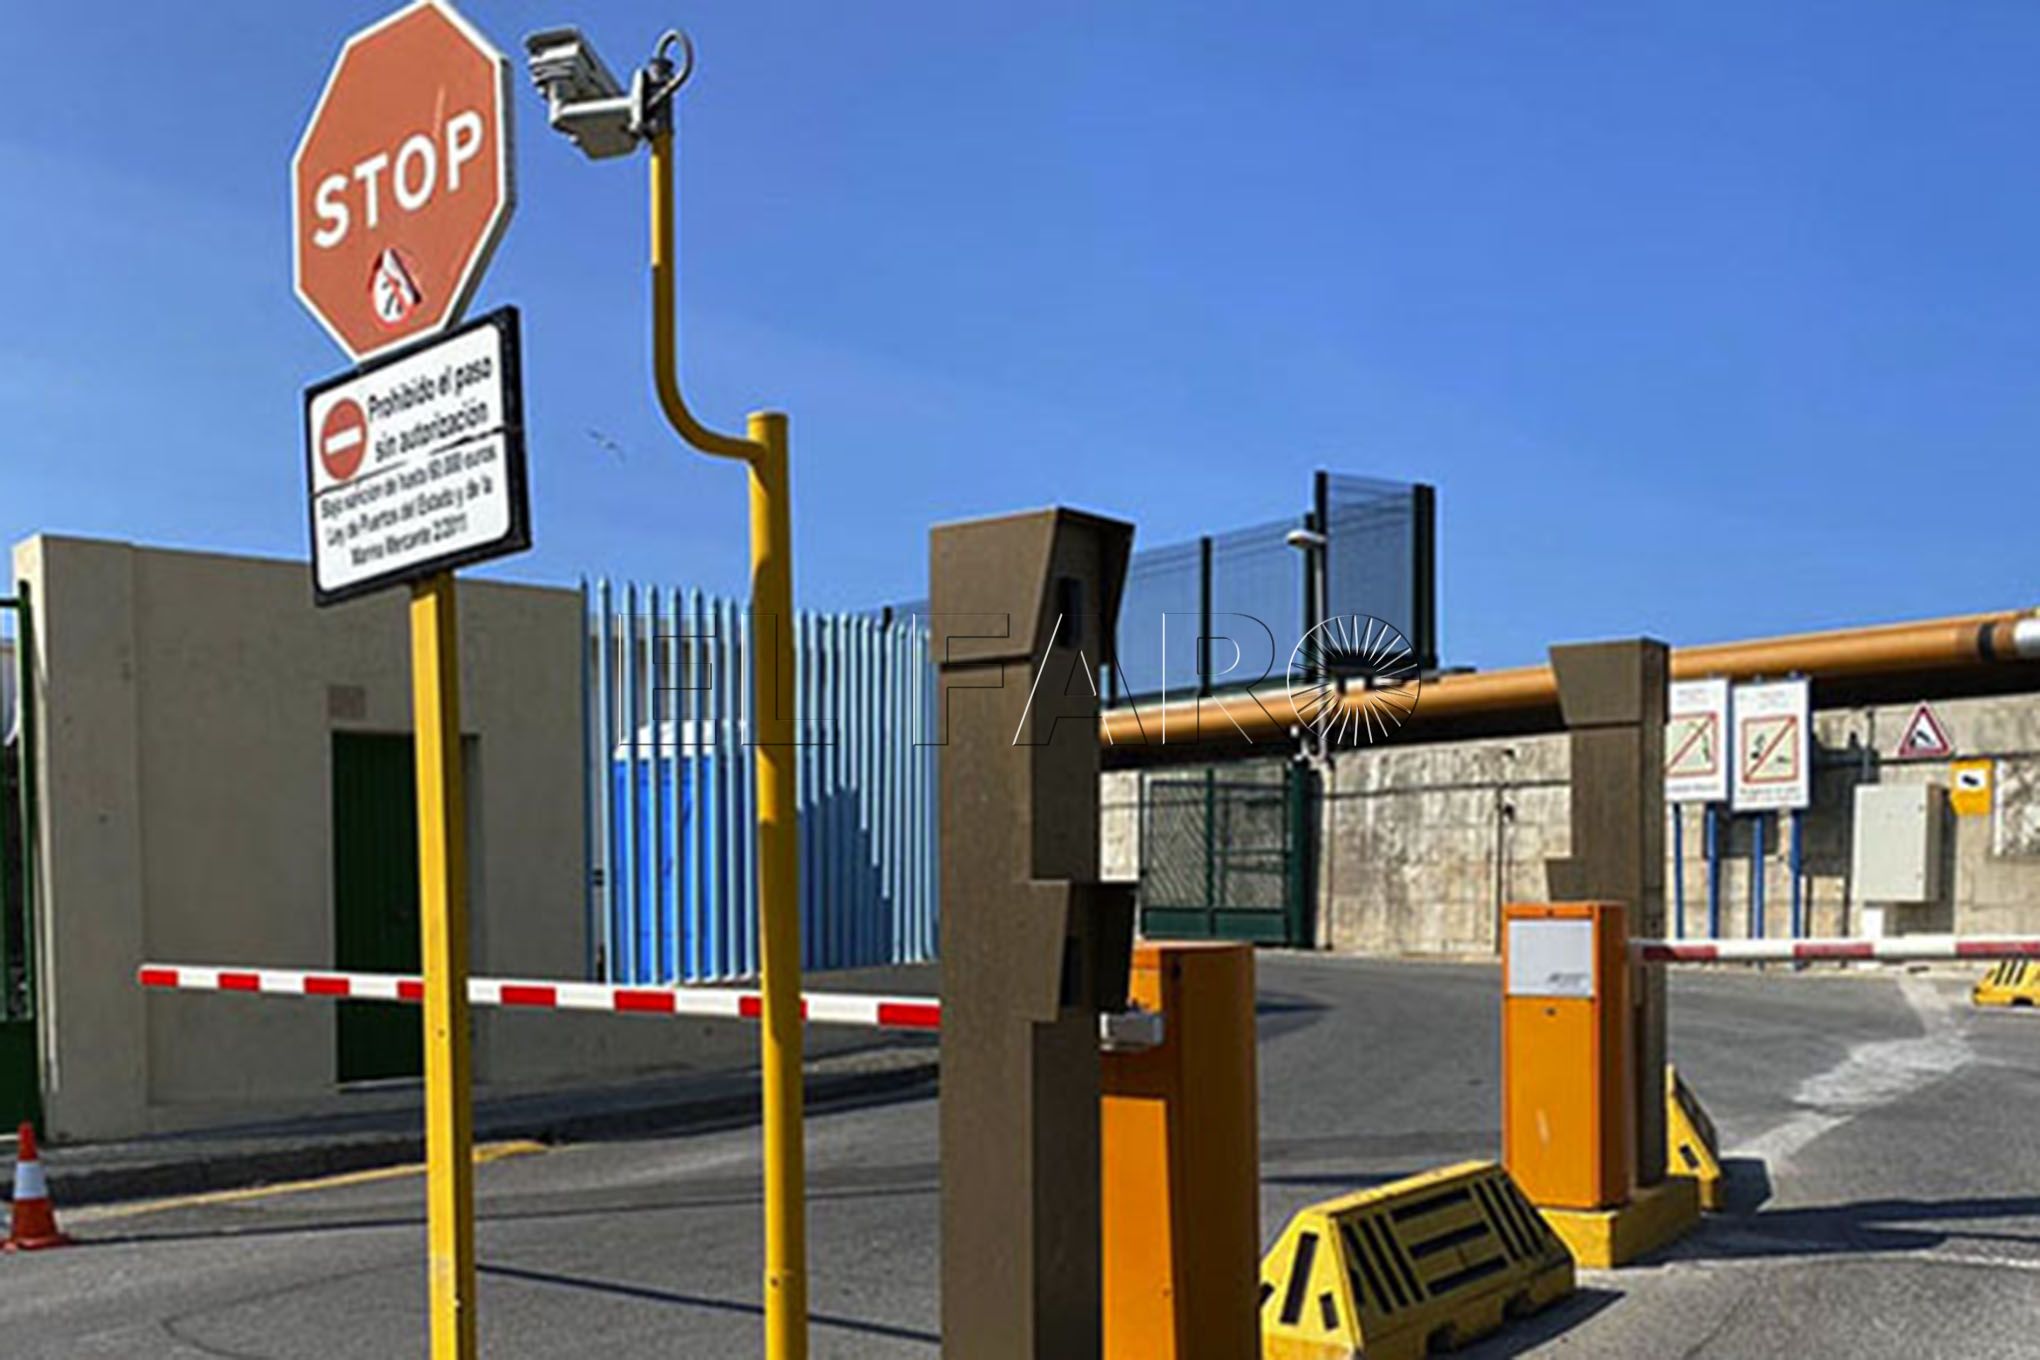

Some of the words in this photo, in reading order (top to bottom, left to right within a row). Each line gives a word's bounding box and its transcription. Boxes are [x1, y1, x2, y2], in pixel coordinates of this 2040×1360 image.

[313, 110, 483, 248] STOP
[368, 375, 435, 422] Prohibido
[439, 365, 451, 396] el
[455, 357, 492, 396] paso
[375, 432, 396, 462] sin
[400, 399, 488, 453] autorización
